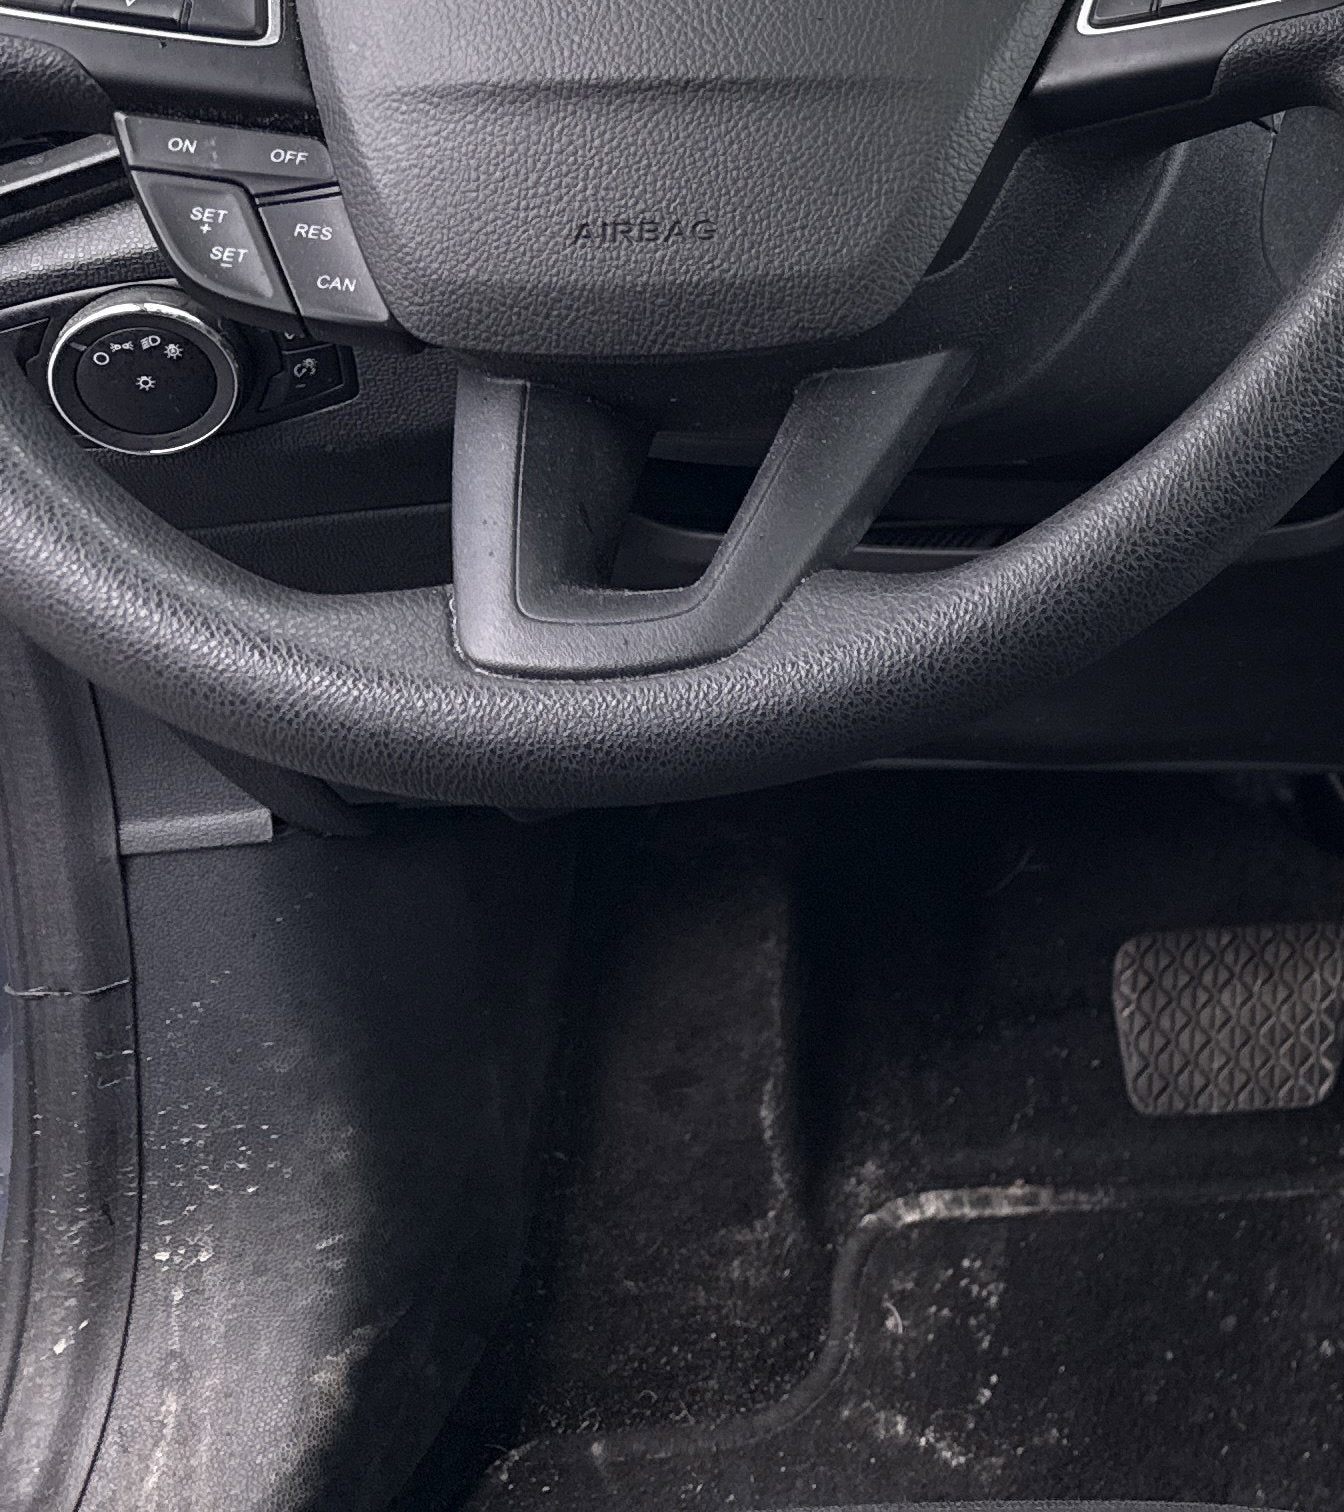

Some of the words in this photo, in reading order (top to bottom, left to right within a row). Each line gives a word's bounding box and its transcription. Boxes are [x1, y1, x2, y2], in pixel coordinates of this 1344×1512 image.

[168, 136, 198, 155] ON
[269, 148, 310, 167] OFF
[190, 205, 228, 225] SET
[293, 222, 334, 242] RES
[569, 219, 718, 245] AIRBAG
[209, 244, 249, 265] SET
[316, 274, 358, 293] CAN
